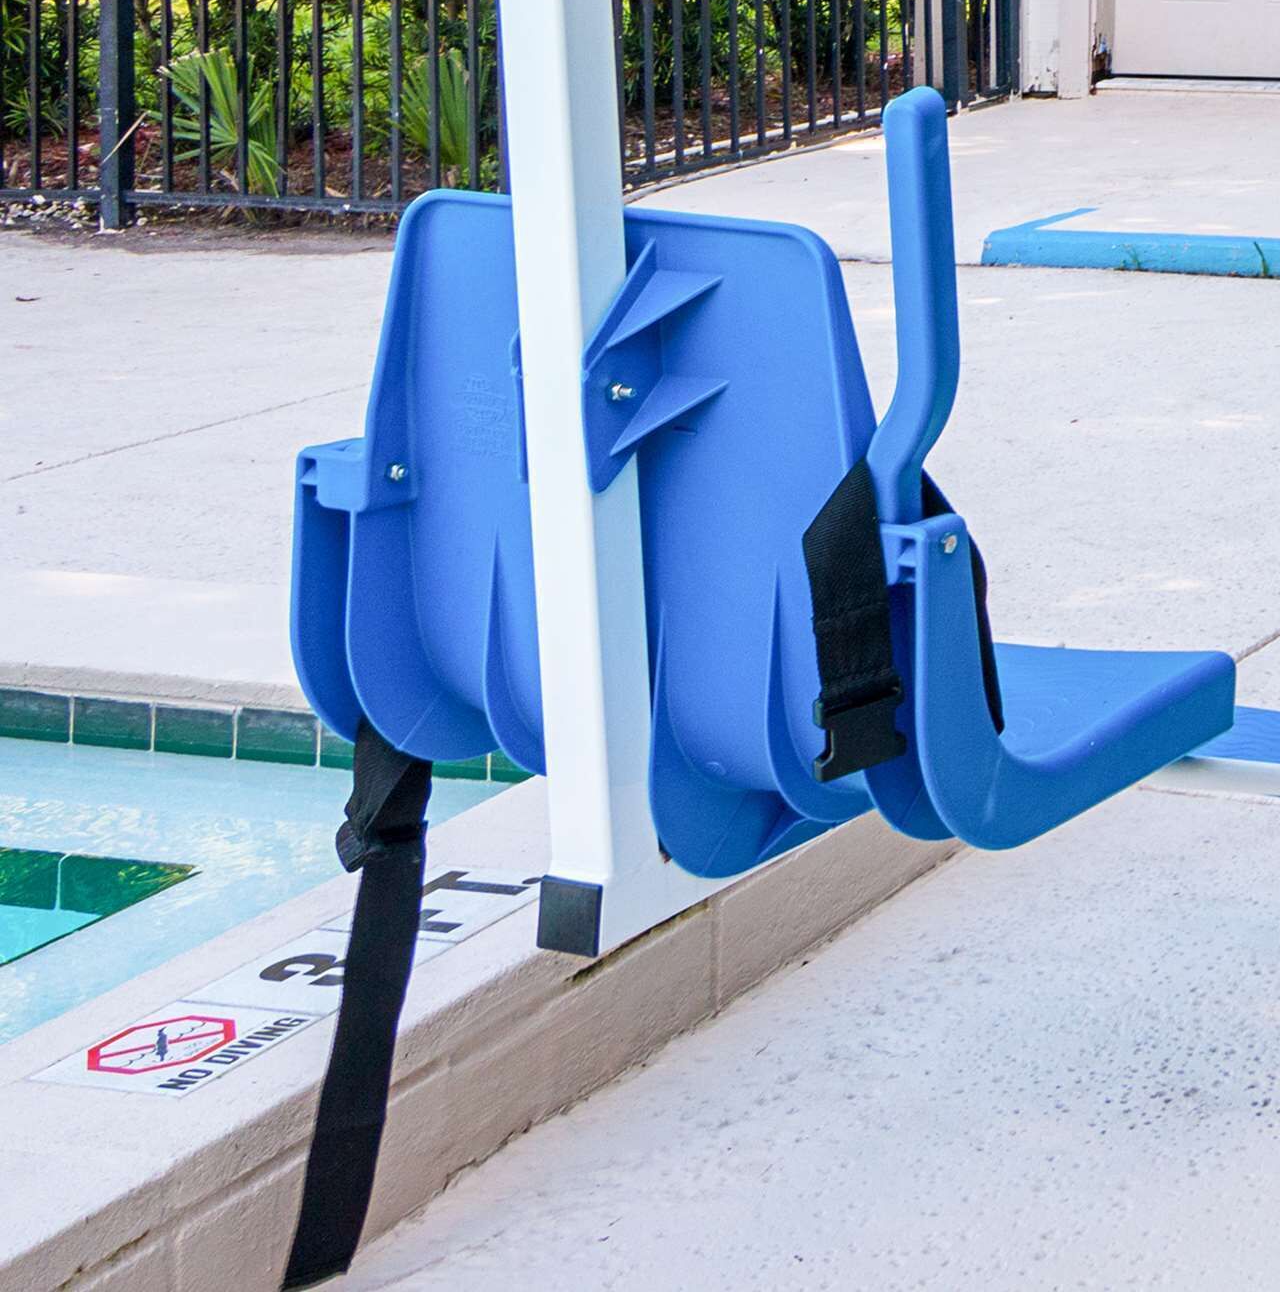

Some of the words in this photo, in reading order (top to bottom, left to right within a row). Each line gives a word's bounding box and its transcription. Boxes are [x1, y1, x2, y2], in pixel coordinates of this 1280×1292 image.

[259, 953, 346, 986] 3
[157, 1069, 214, 1090] NO
[203, 1017, 311, 1064] DIVING
